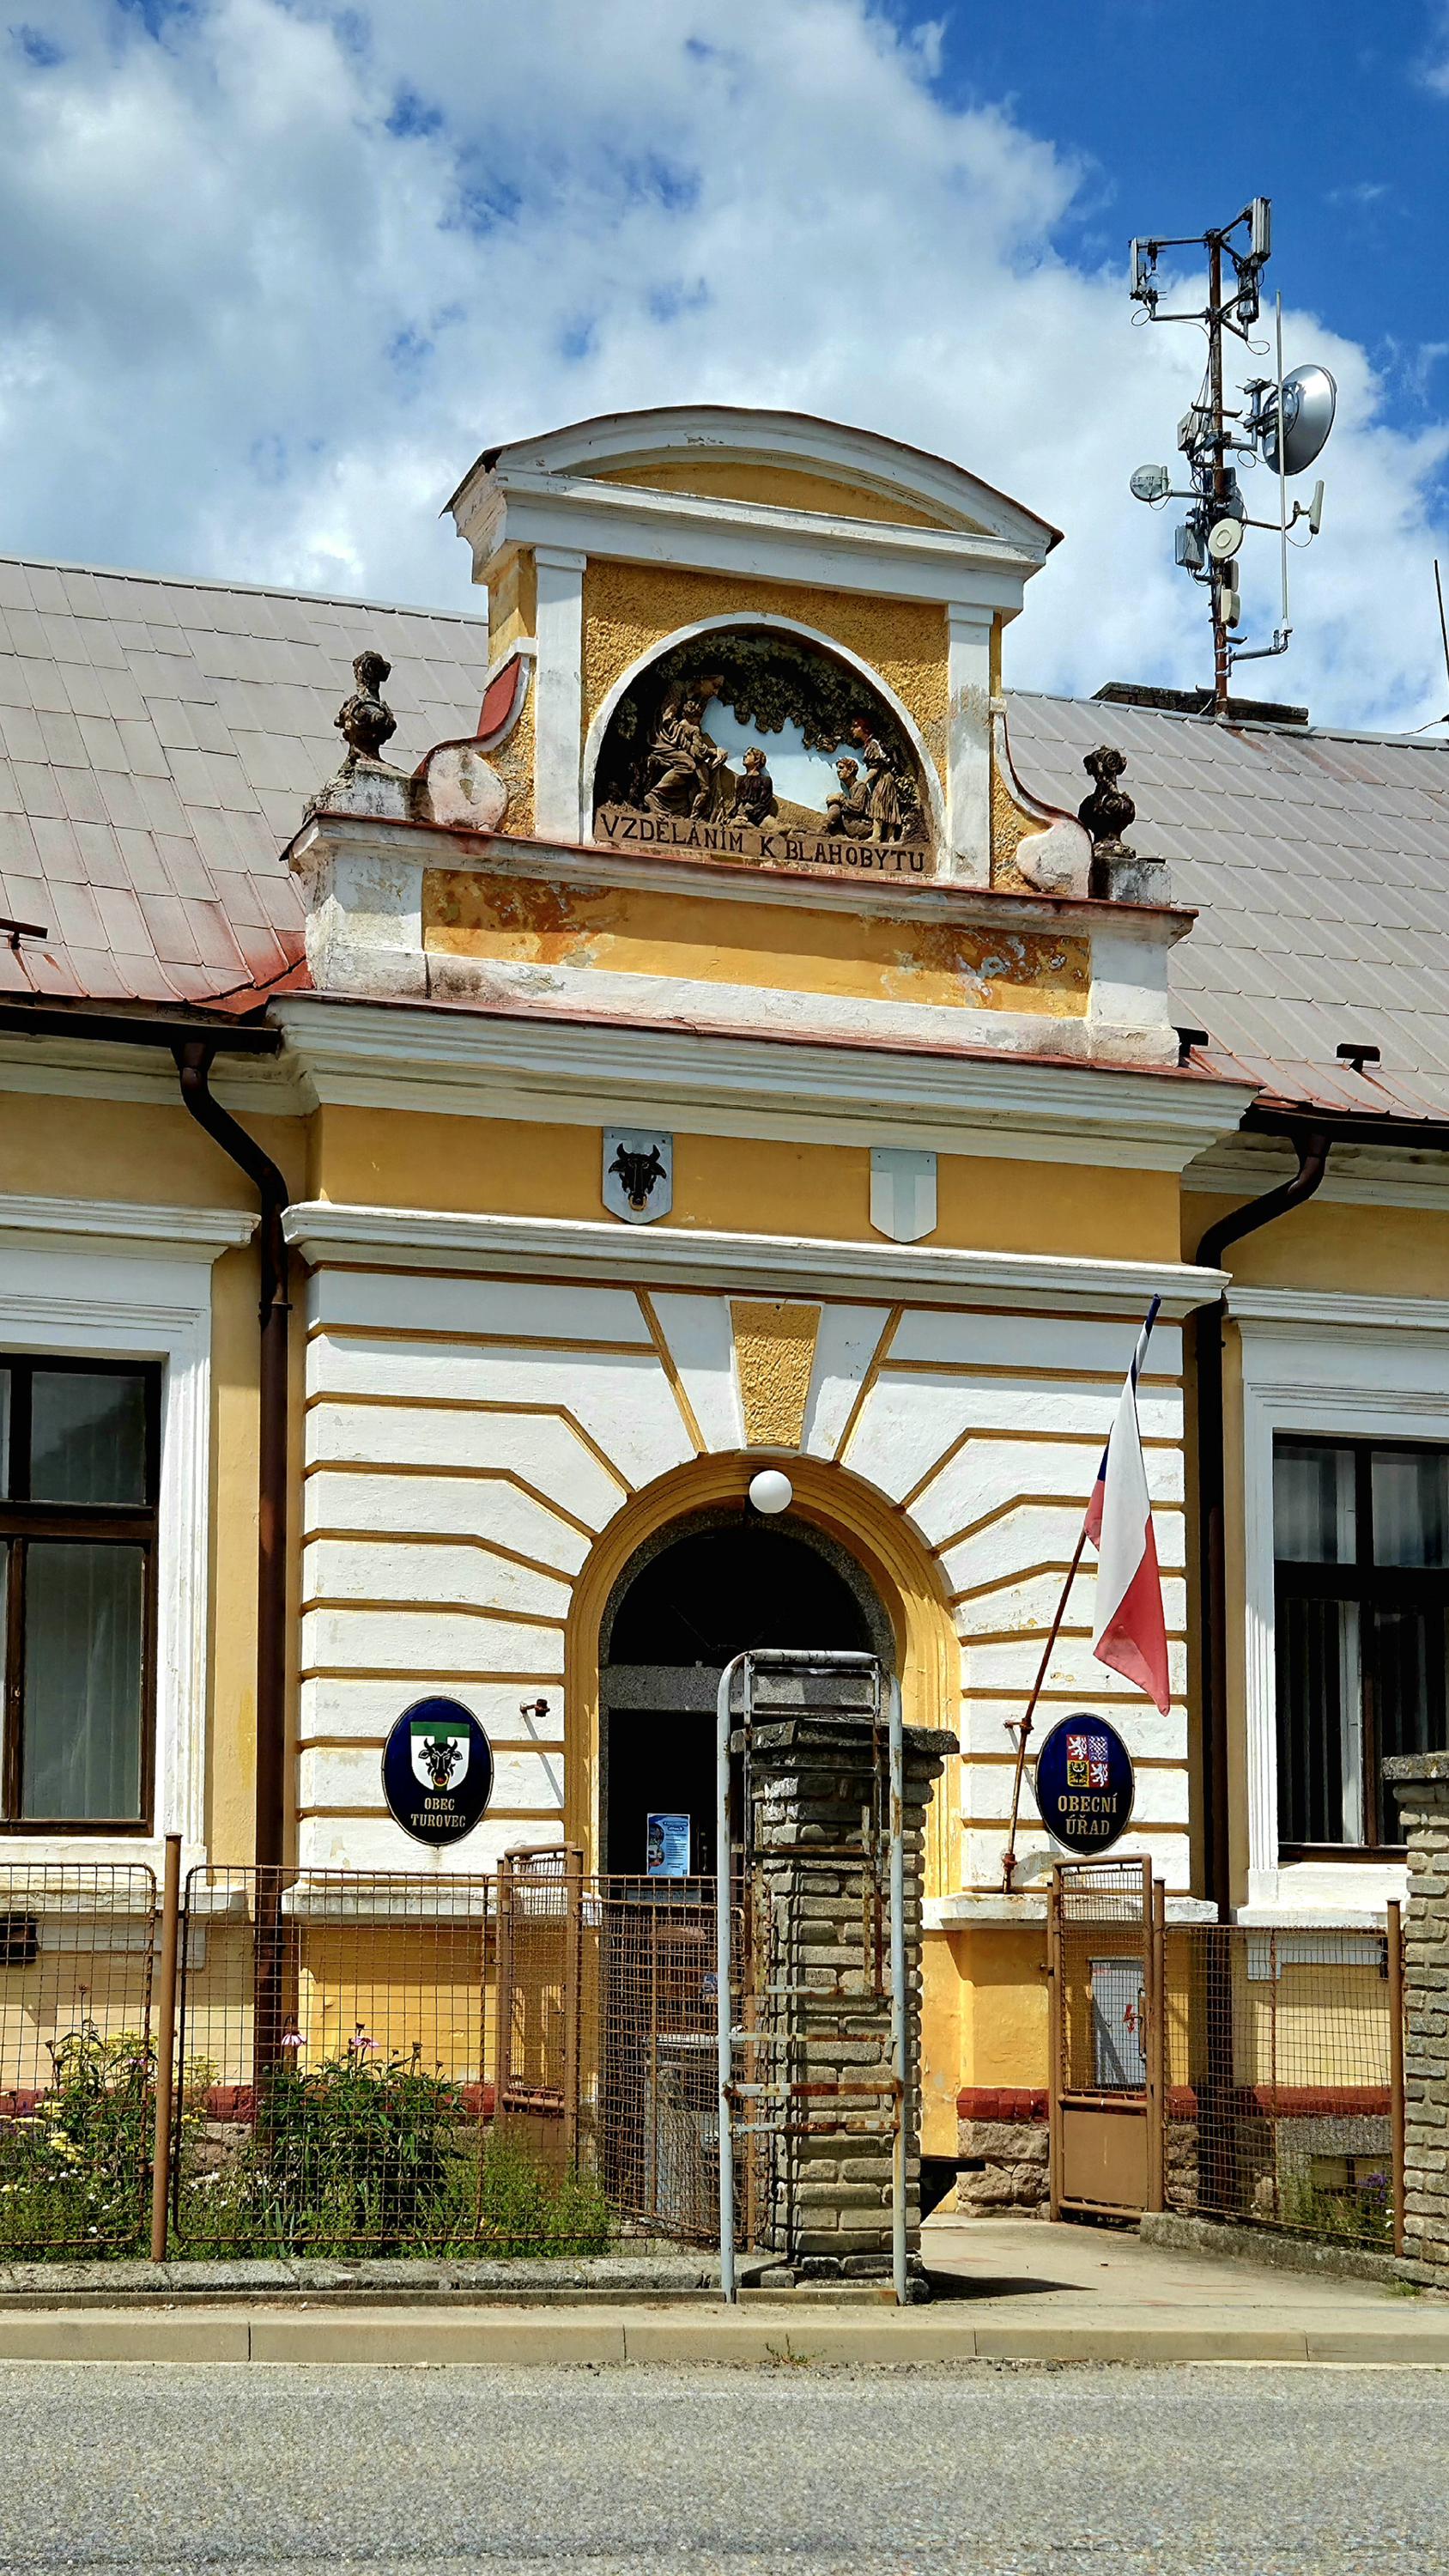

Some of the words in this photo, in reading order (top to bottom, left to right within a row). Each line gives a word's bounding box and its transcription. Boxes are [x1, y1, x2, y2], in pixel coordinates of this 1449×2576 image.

[600, 813, 743, 853] VZDĚLÁNÍM
[759, 835, 776, 858] K
[785, 840, 925, 872] BLAHOBYTU
[424, 1797, 455, 1811] OBEC
[1058, 1792, 1118, 1813] OBECNÍ
[410, 1814, 466, 1827] TUROVEC
[1065, 1814, 1110, 1835] ÚŘAD
